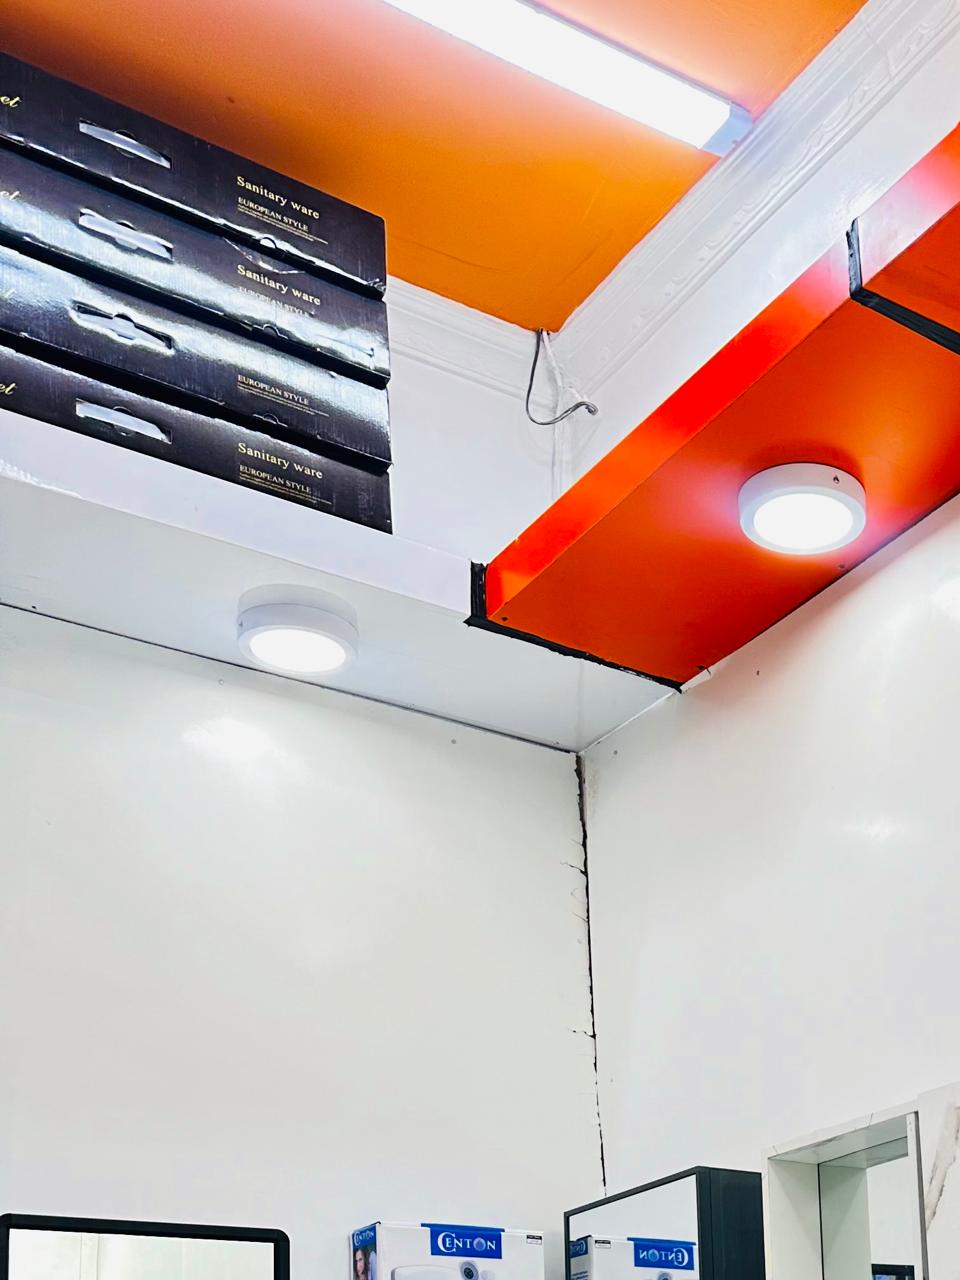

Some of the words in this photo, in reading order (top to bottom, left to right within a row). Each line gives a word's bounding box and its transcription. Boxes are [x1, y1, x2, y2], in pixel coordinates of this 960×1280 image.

[236, 176, 288, 207] Sanitary
[291, 201, 320, 219] ware
[237, 197, 282, 220] EUROPEAN
[283, 215, 309, 232] STYLE
[236, 265, 288, 294] Sanitary
[292, 289, 321, 305] ware
[237, 374, 282, 396] EUROPEAN
[283, 391, 309, 405] STYLE
[238, 442, 290, 470] Sanitary
[293, 462, 323, 479] ware
[239, 464, 285, 484] EUROPEAN
[285, 479, 312, 493] STYLE
[437, 1231, 496, 1253] CENTON
